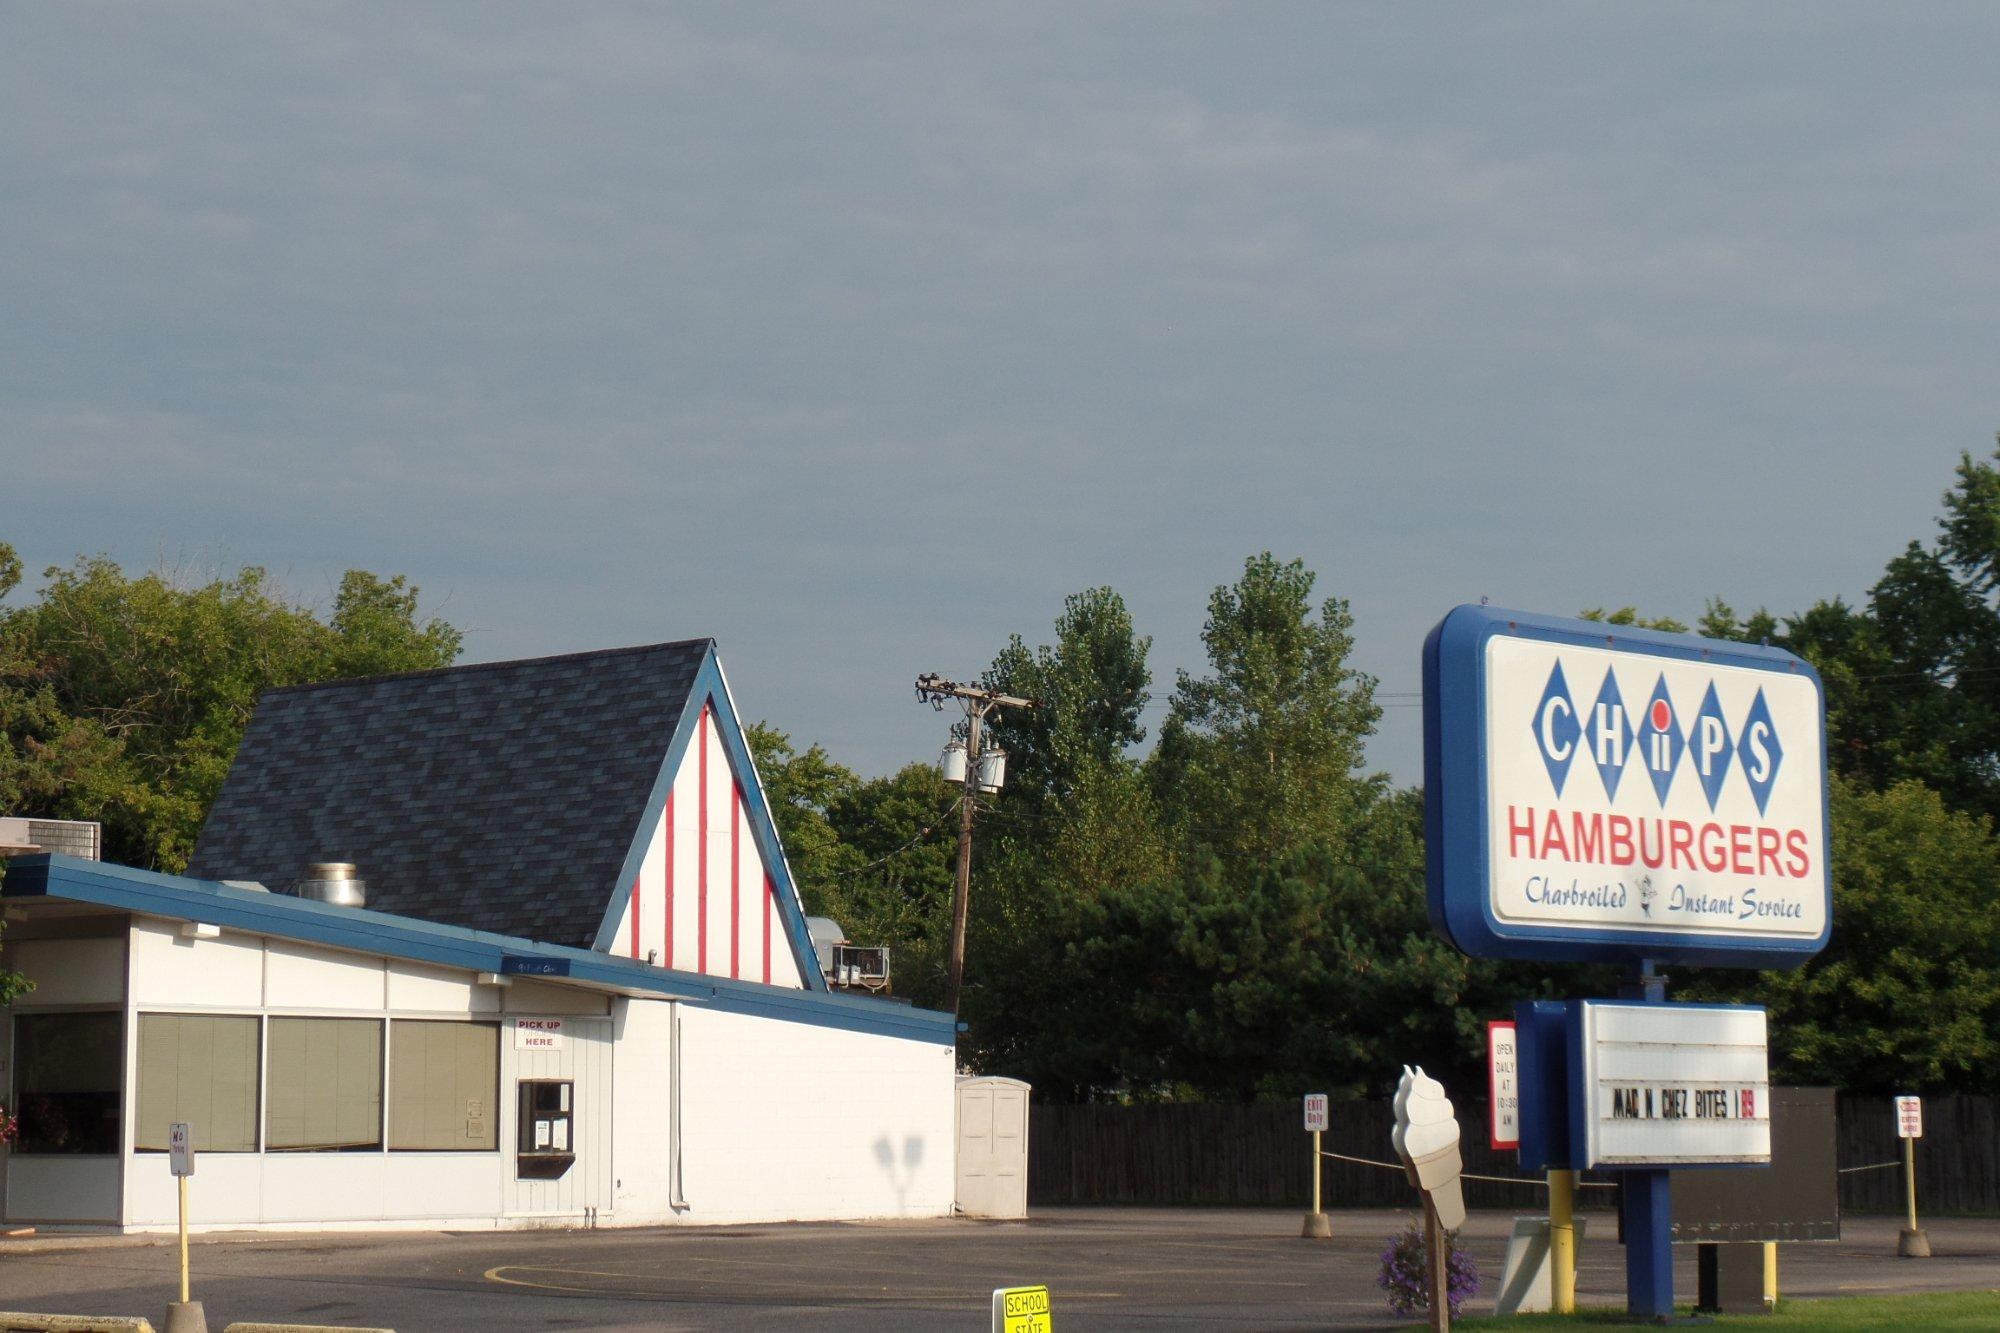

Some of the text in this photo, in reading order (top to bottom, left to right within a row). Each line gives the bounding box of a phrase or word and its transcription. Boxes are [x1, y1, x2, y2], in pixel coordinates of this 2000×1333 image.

[1508, 805, 1810, 879] HAMBURGERS
[1525, 876, 1802, 920] Charbroiled Instant Service
[519, 1020, 561, 1029] PICK UP
[525, 1038, 553, 1046] HERE
[1496, 1044, 1514, 1055] OPEN
[1496, 1062, 1515, 1073] DAILY
[1502, 1079, 1510, 1091] AT
[1307, 1099, 1323, 1111] EXIT
[1497, 1097, 1517, 1109] 10:30
[1613, 1088, 1639, 1118] MAC
[1645, 1088, 1653, 1118] N
[1662, 1089, 1688, 1120] CHEZ
[1695, 1089, 1727, 1119] BITES
[1007, 1294, 1047, 1313] SCHOOL
